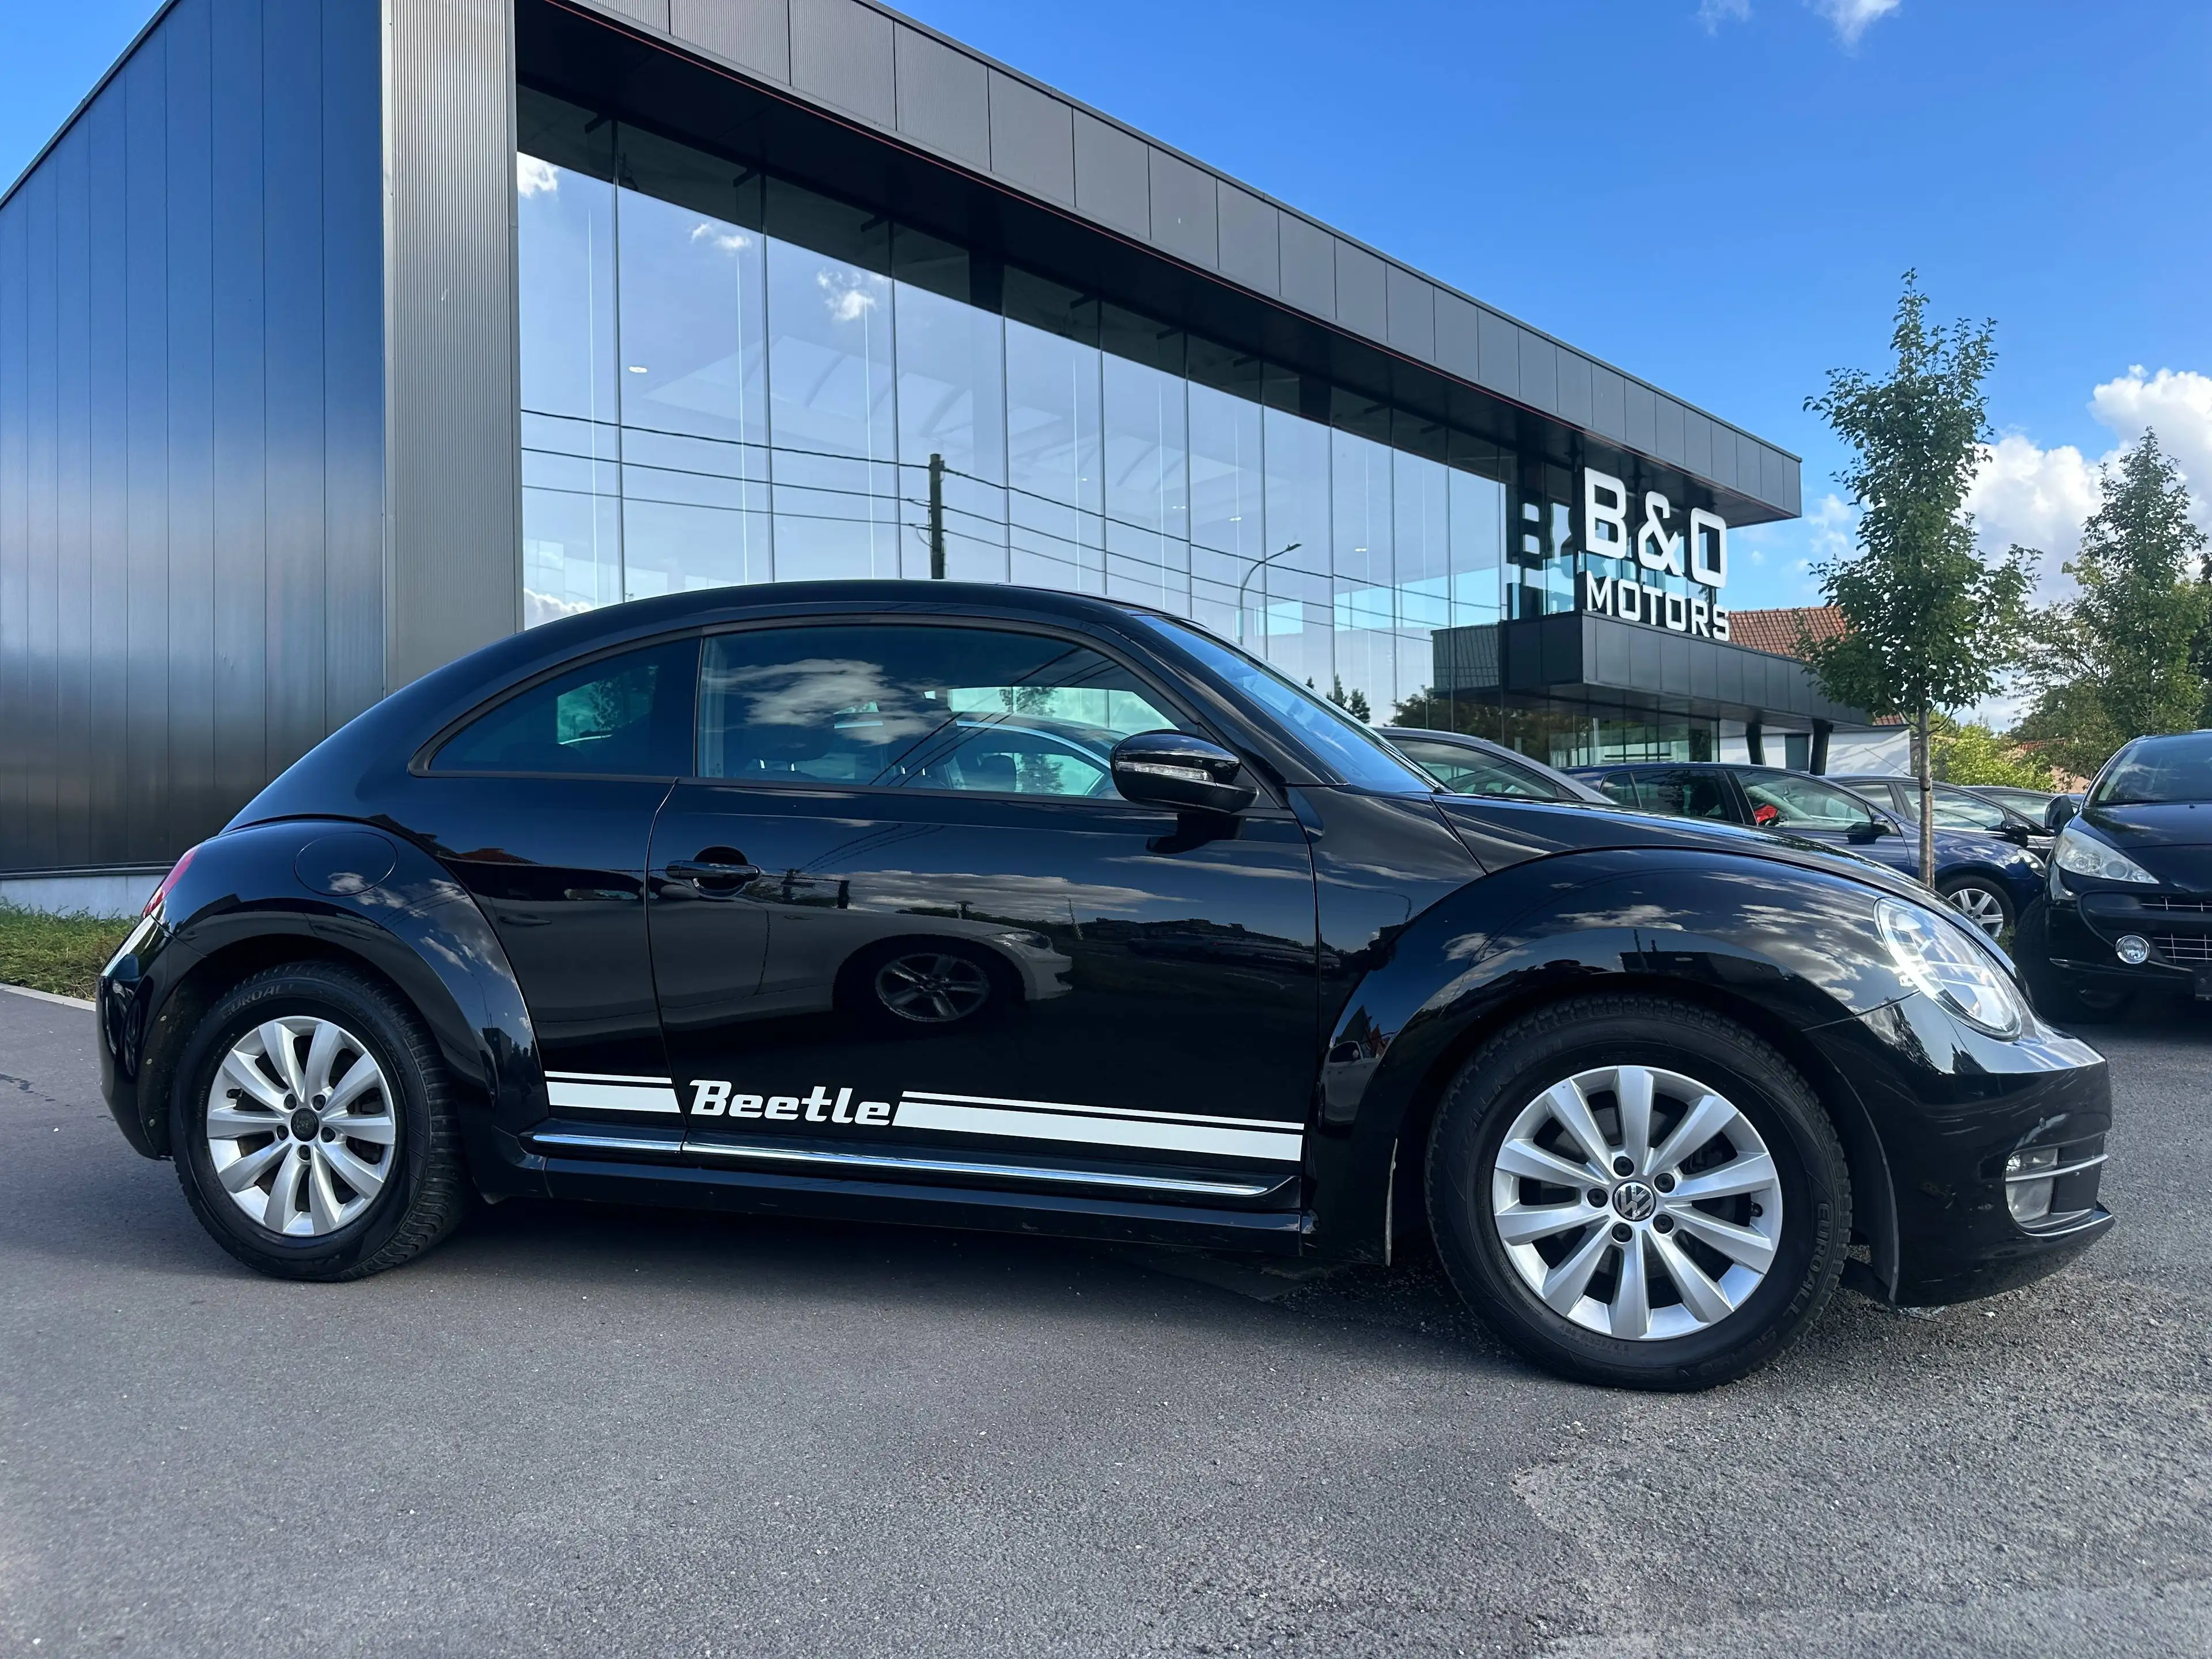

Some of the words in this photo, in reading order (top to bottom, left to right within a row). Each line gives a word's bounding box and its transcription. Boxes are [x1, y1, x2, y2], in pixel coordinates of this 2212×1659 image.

[1585, 467, 1728, 589] B&O
[1586, 570, 1730, 642] MOTORS
[690, 1080, 891, 1126] Beetle
[1782, 1203, 1830, 1317] EUROALL
